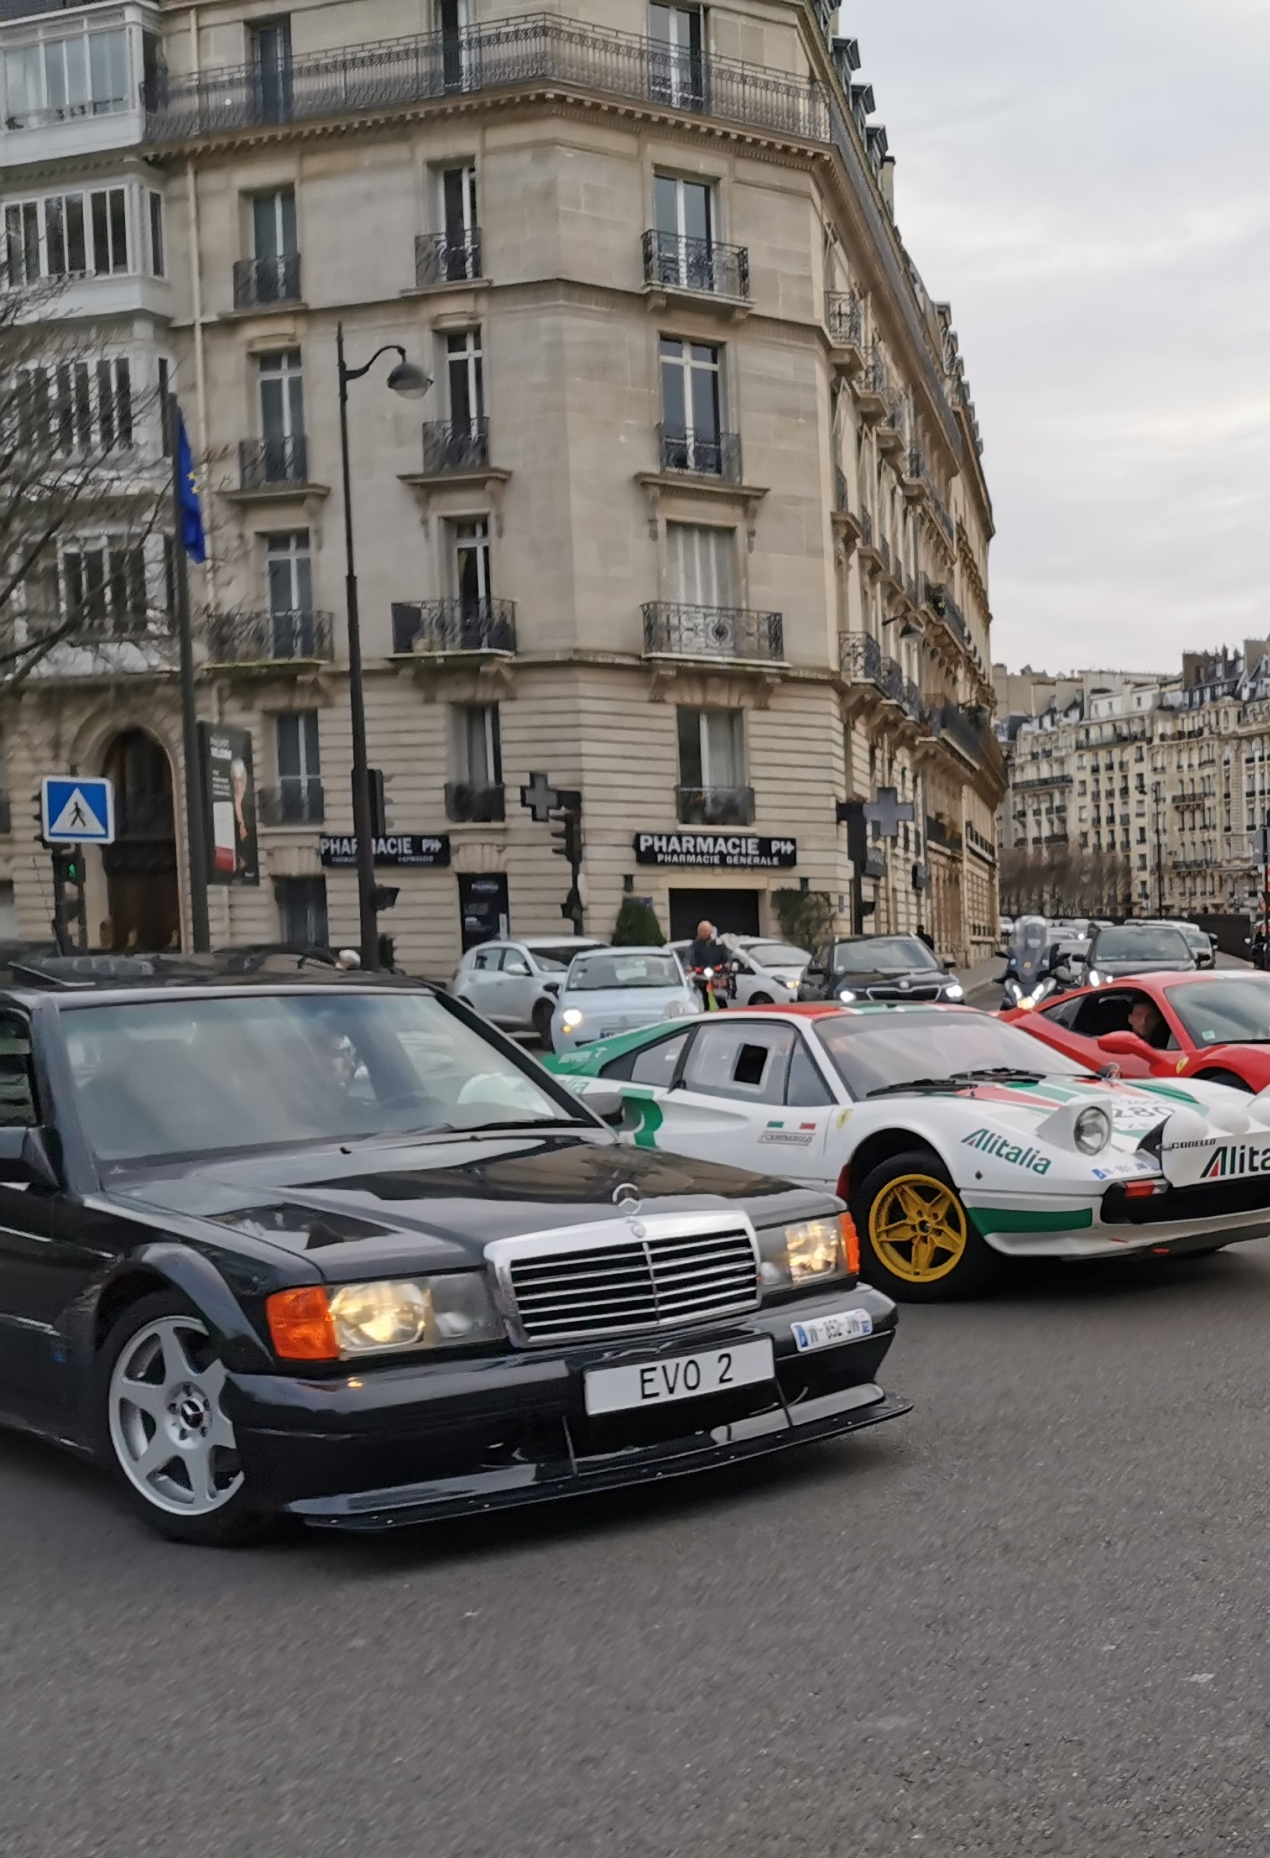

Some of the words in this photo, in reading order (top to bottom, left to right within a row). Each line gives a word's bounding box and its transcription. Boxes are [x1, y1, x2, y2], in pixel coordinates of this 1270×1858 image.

[639, 834, 760, 855] PHARMACIE
[657, 853, 720, 864] PHARMACIE
[960, 1127, 1052, 1176] Alitalia
[639, 1359, 700, 1400] EVO
[717, 1352, 734, 1385] 2
